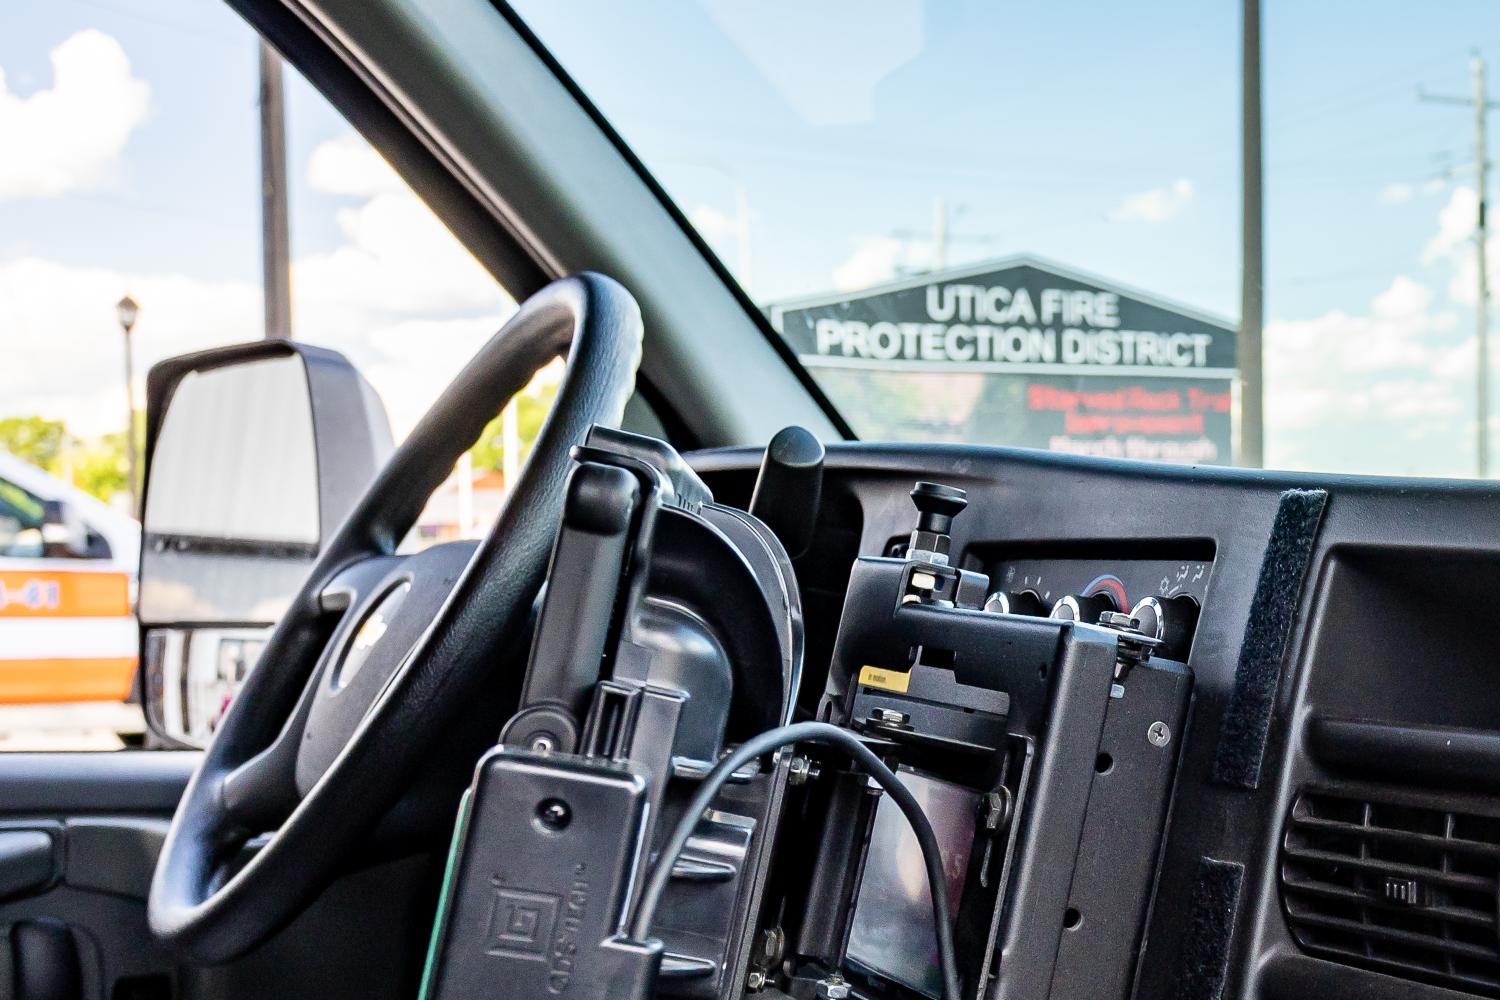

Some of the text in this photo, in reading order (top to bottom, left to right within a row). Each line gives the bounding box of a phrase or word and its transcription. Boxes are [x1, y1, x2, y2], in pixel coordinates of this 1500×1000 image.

[926, 284, 1120, 327] UTICA FIRE
[816, 318, 1213, 367] PROTECTION DISTRICT
